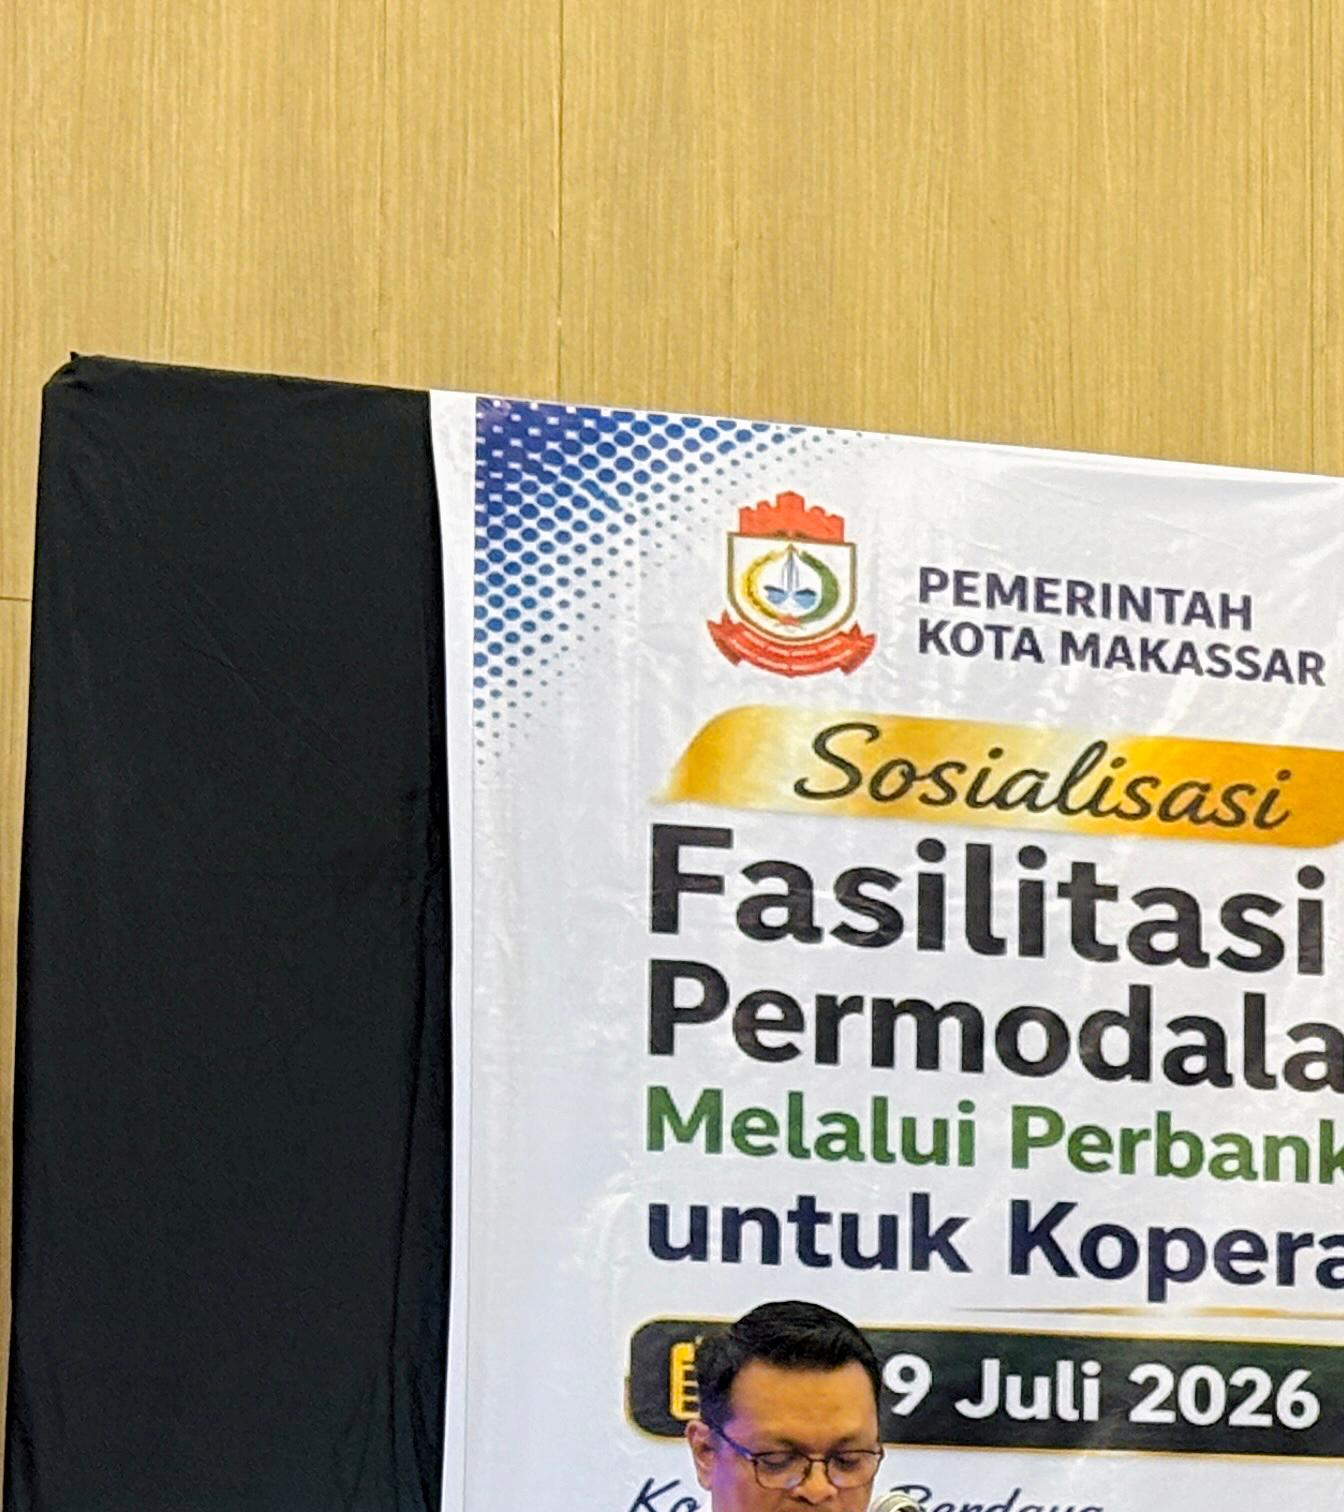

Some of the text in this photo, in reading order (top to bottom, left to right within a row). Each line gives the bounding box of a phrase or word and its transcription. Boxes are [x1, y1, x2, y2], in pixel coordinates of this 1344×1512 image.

[918, 565, 1253, 632] PEMERINTAH
[918, 619, 1327, 687] KOTA MAKASSAR
[794, 721, 1291, 832] Sosialisasi
[649, 822, 1326, 977] Fasilitasi
[645, 1085, 977, 1168] Melalui
[648, 1191, 972, 1273] untuk
[955, 1358, 1101, 1422] Juli
[1129, 1363, 1320, 1429] 2026
